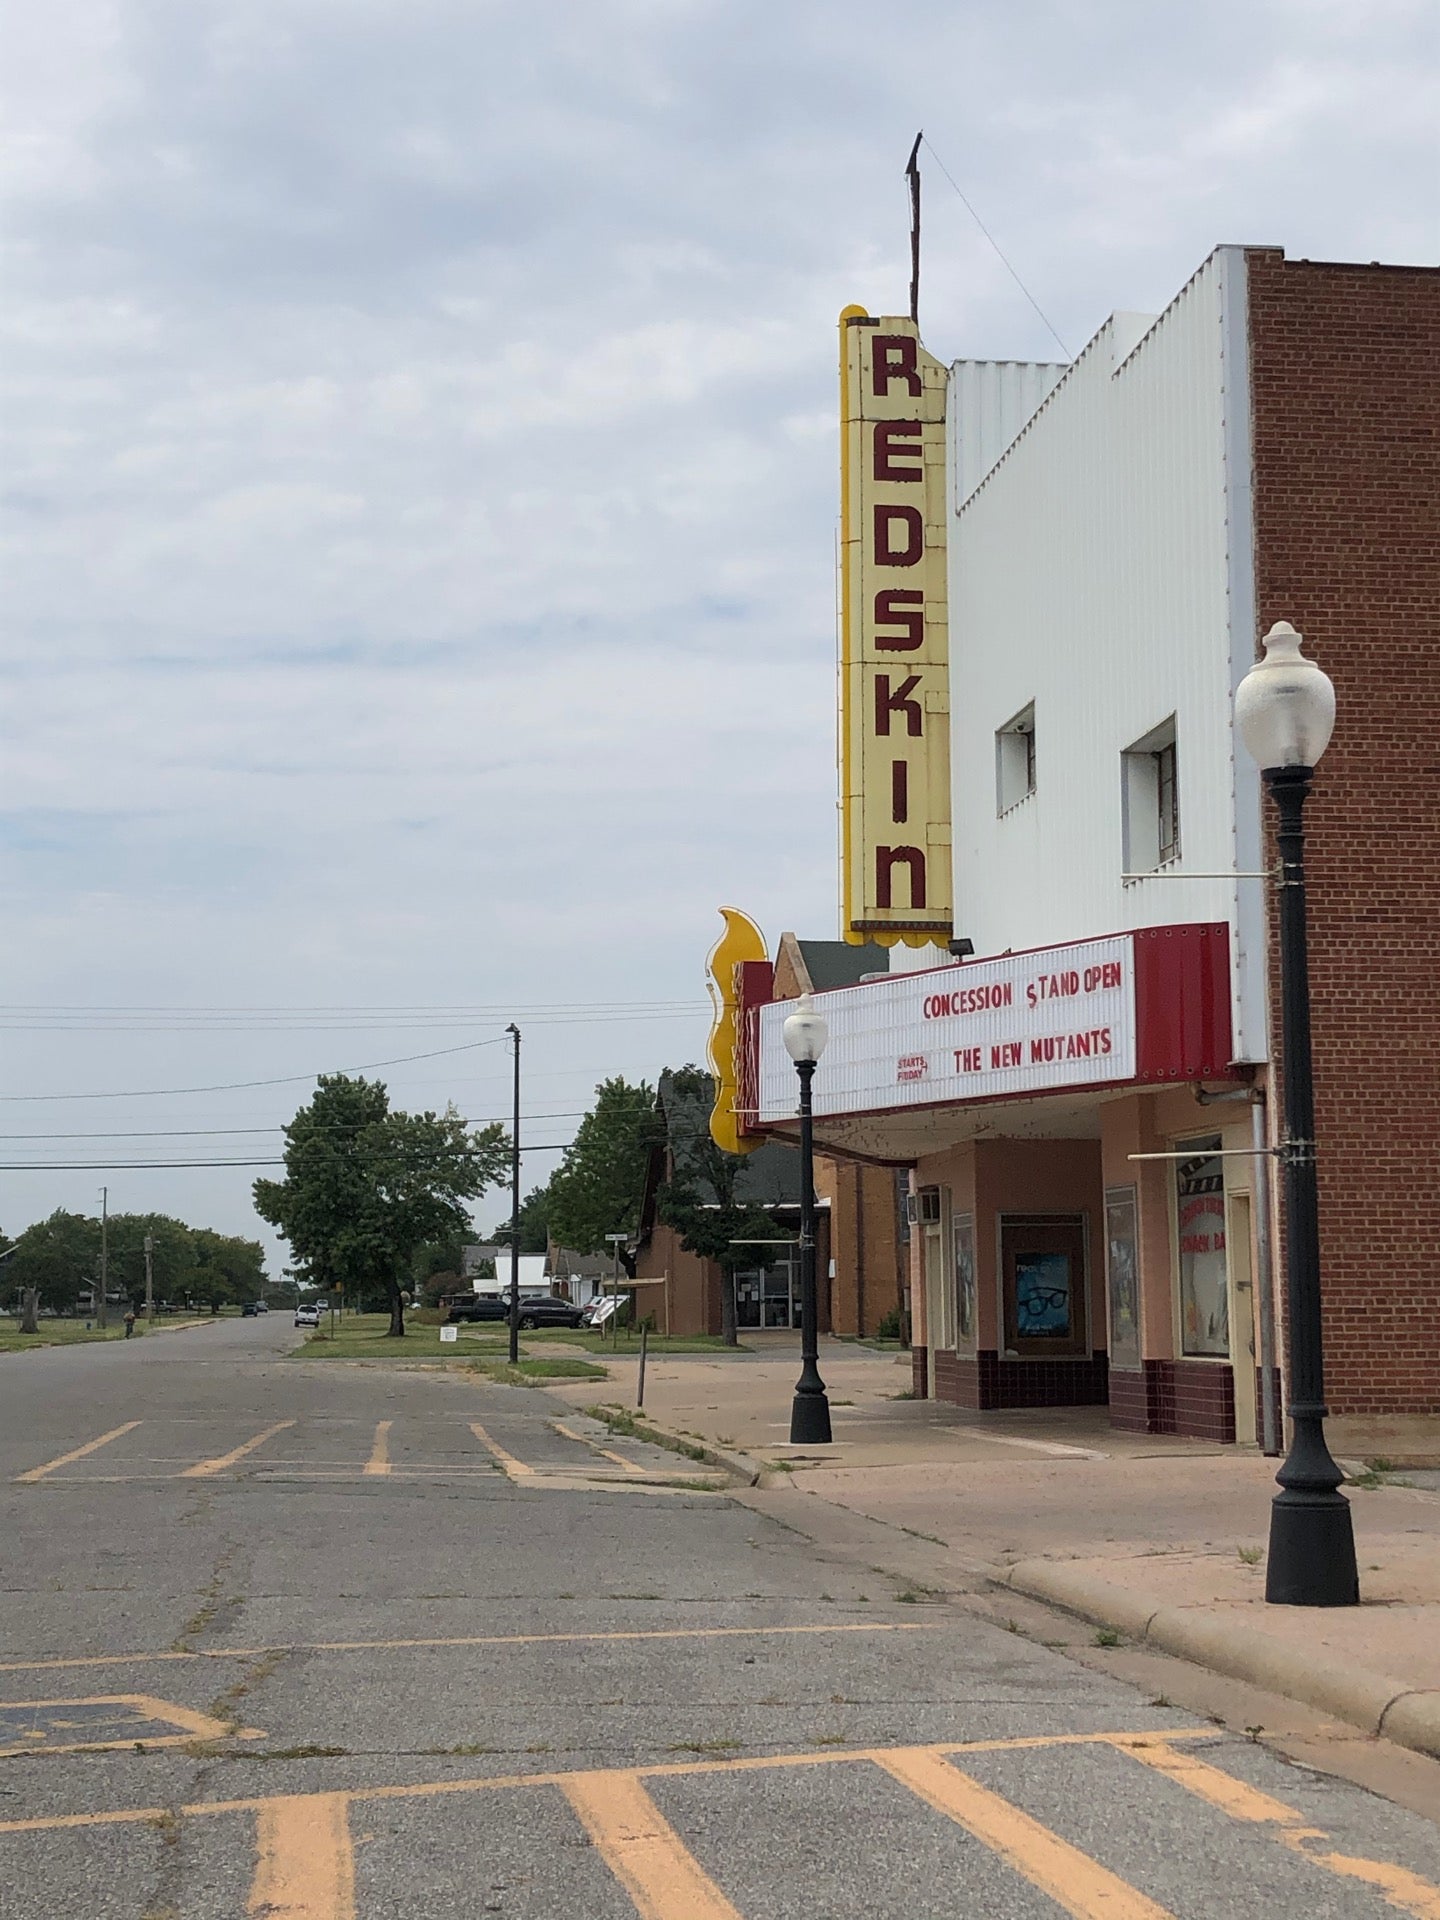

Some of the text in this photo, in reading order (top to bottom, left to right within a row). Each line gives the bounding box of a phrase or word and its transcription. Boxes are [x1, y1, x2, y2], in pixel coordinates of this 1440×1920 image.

[923, 961, 1122, 1020] CONCESSION STAND OPEN
[897, 1056, 924, 1069] STARTS
[953, 1028, 1112, 1073] THE NEW MUTANTS
[897, 1069, 922, 1081] FRIDAY
